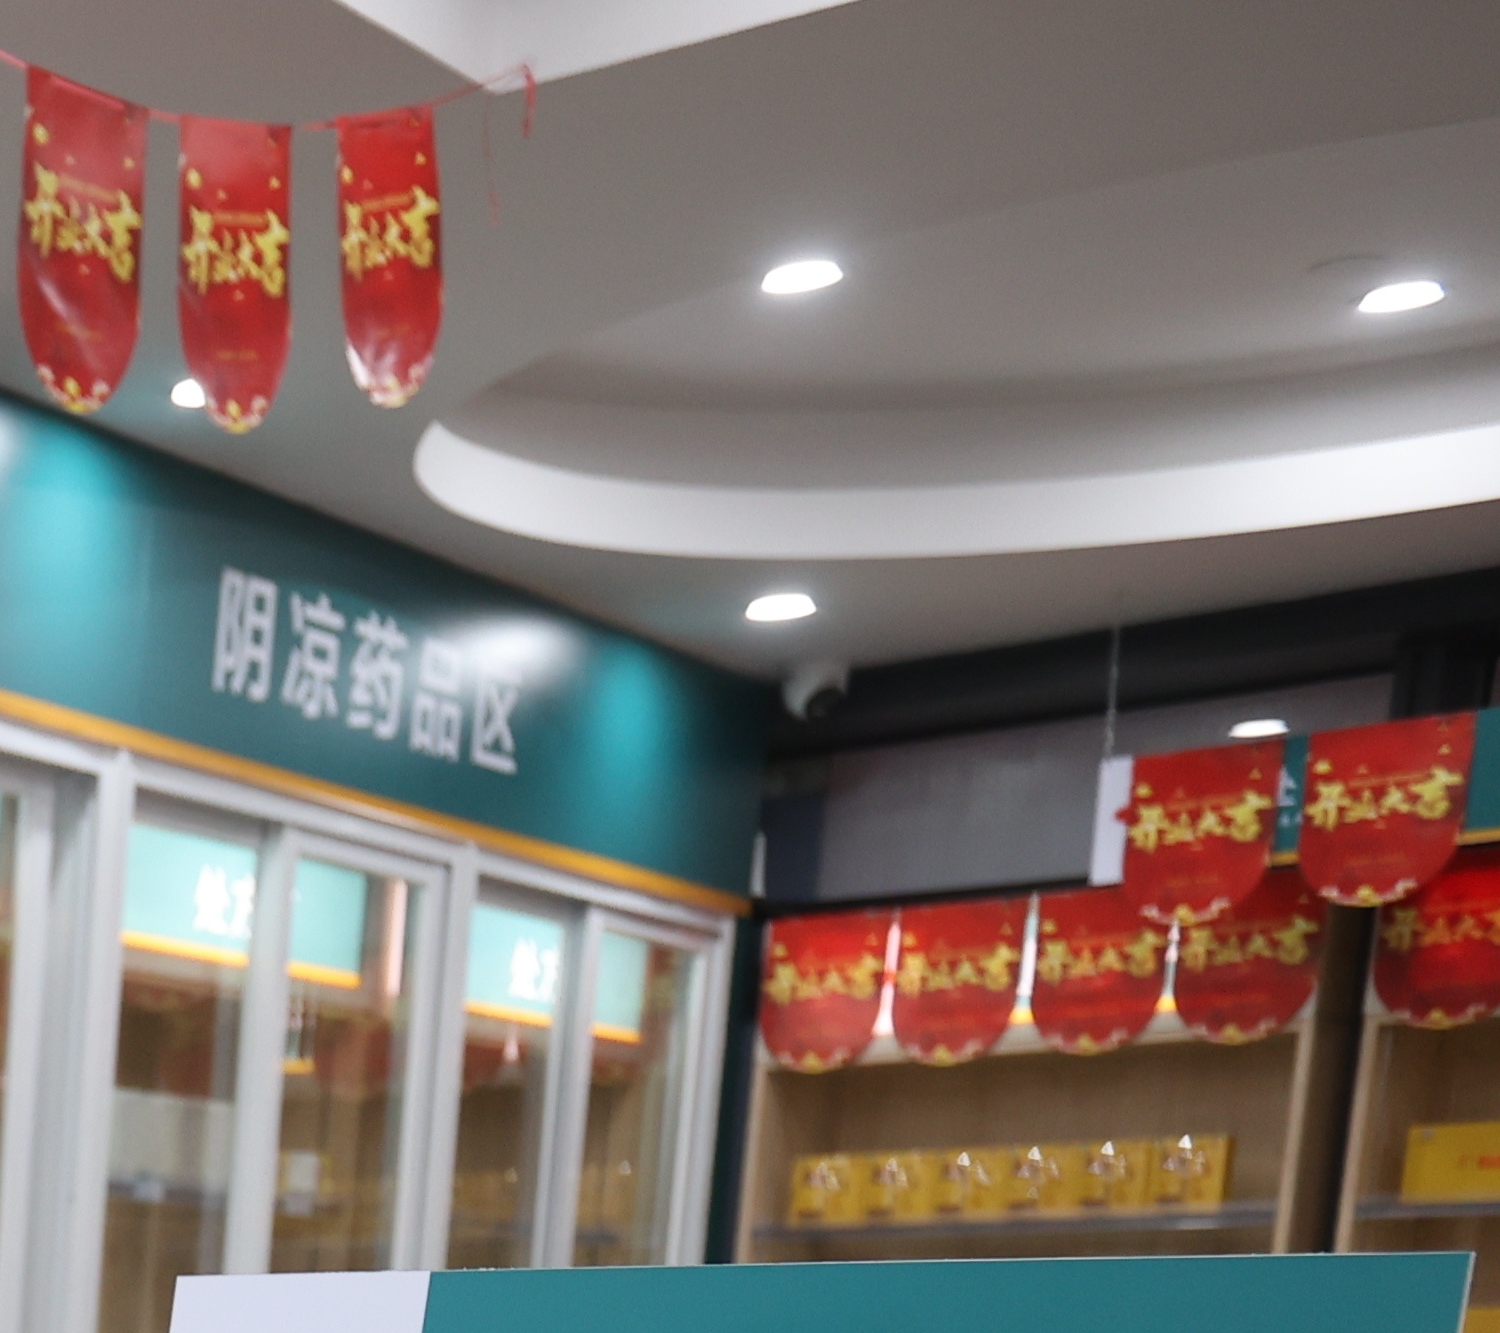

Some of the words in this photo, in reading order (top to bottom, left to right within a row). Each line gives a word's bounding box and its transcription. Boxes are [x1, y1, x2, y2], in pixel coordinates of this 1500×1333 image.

[213, 567, 518, 774] 阴凉药品区
